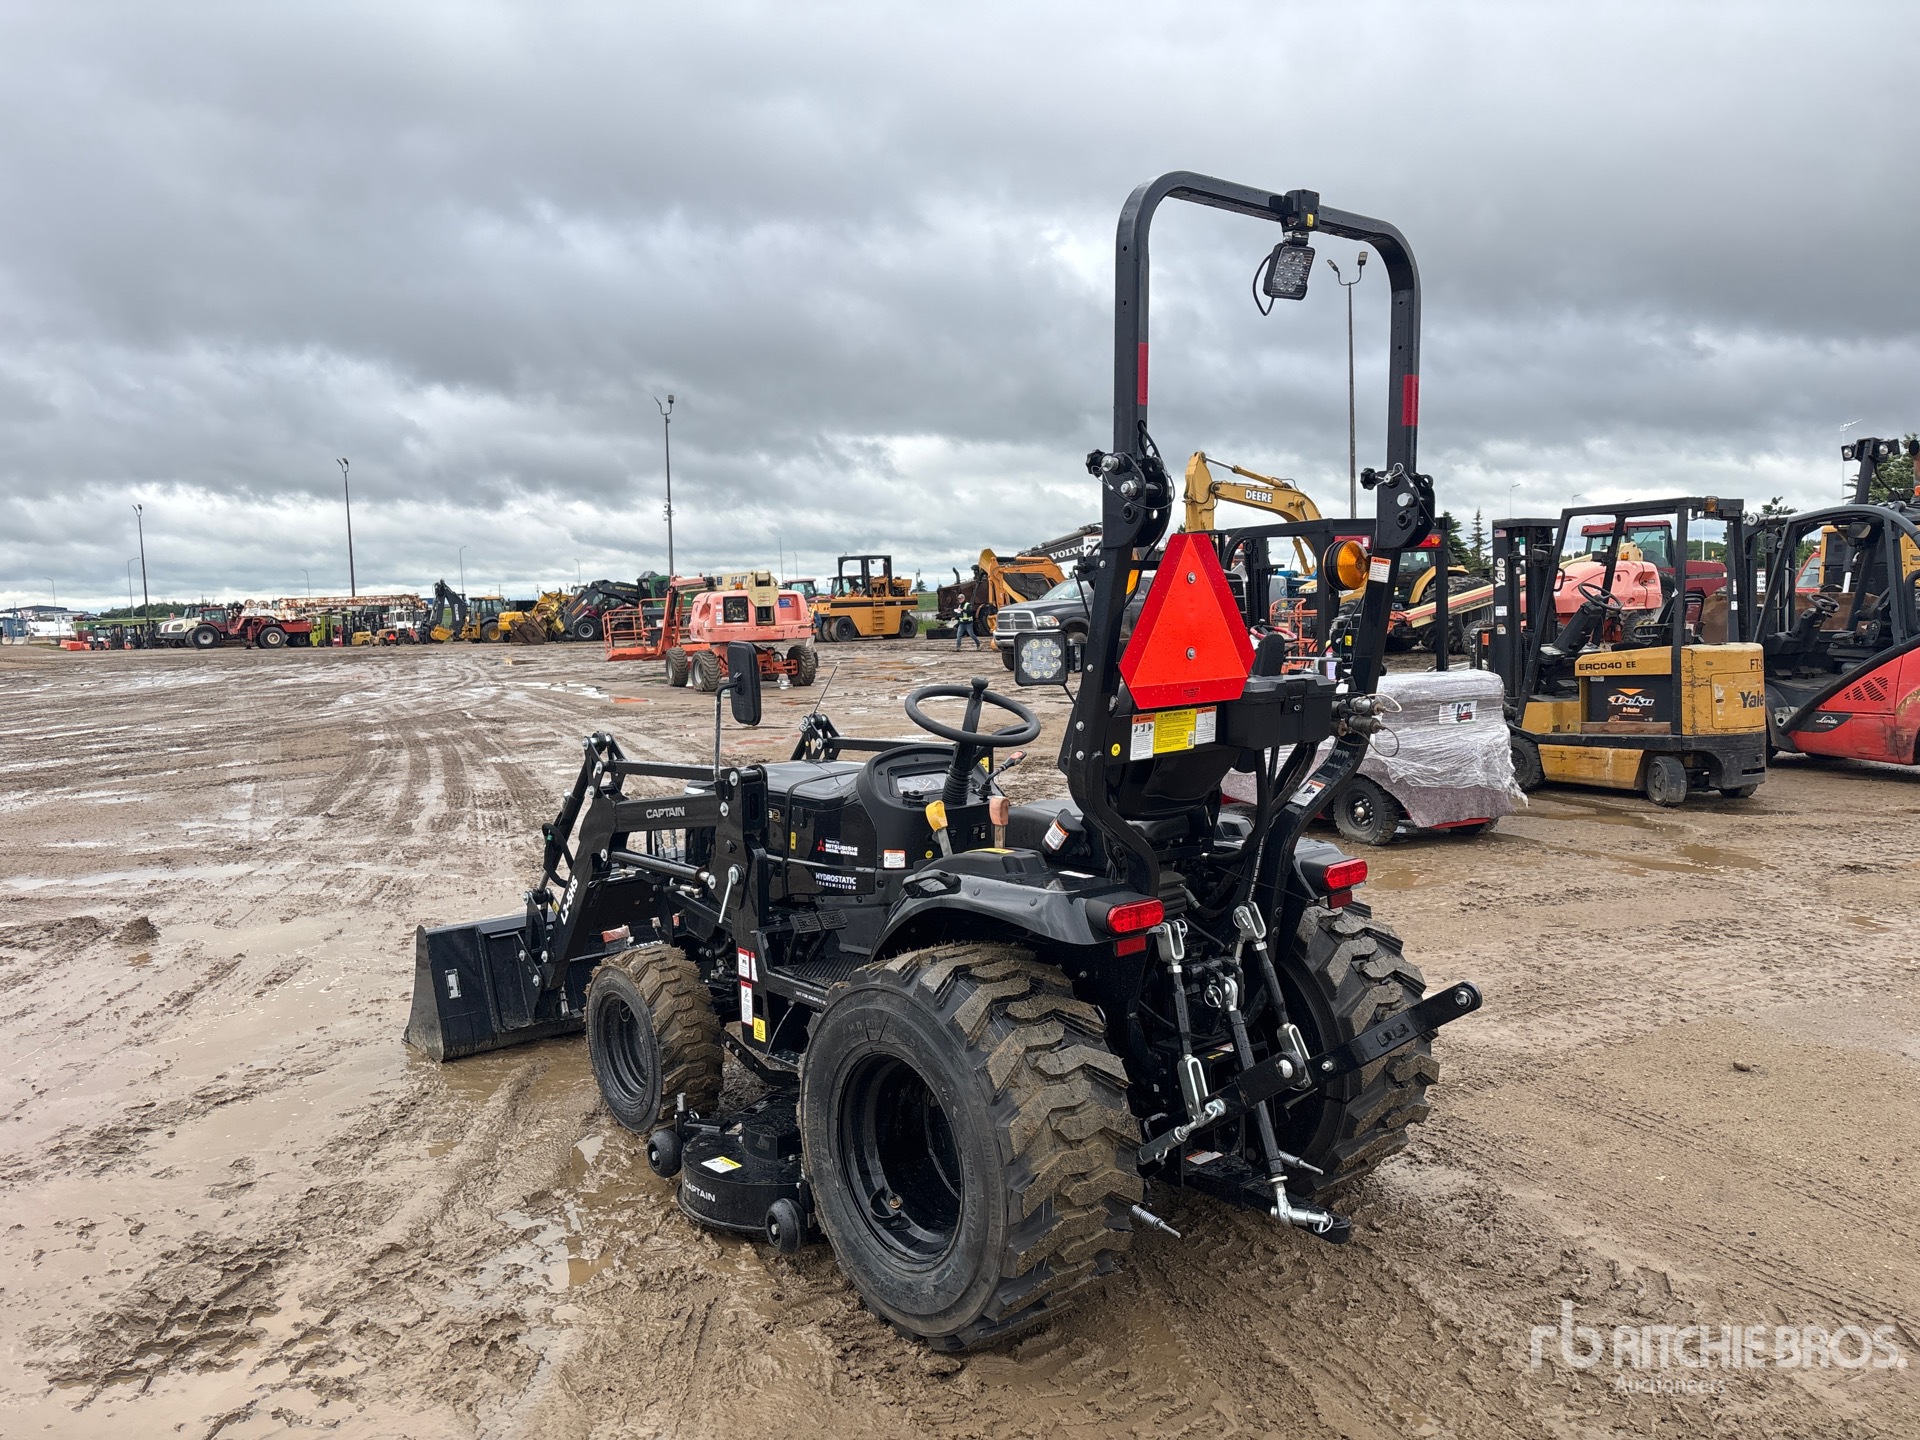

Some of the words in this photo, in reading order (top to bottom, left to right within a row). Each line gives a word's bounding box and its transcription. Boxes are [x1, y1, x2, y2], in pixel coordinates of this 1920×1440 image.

[1245, 489, 1273, 504] DEERE
[1495, 557, 1506, 588] Yale
[1626, 660, 1637, 669] EE
[1608, 694, 1655, 707] Deka
[1740, 691, 1764, 709] Yale
[1816, 715, 1839, 725] Linde
[645, 806, 686, 819] CAPTAIN
[825, 843, 858, 853] MITSUBISHI
[815, 872, 857, 885] HYDROSTATIC
[816, 880, 857, 890] TRANSMISSION
[684, 1179, 716, 1203] CAPTAIN
